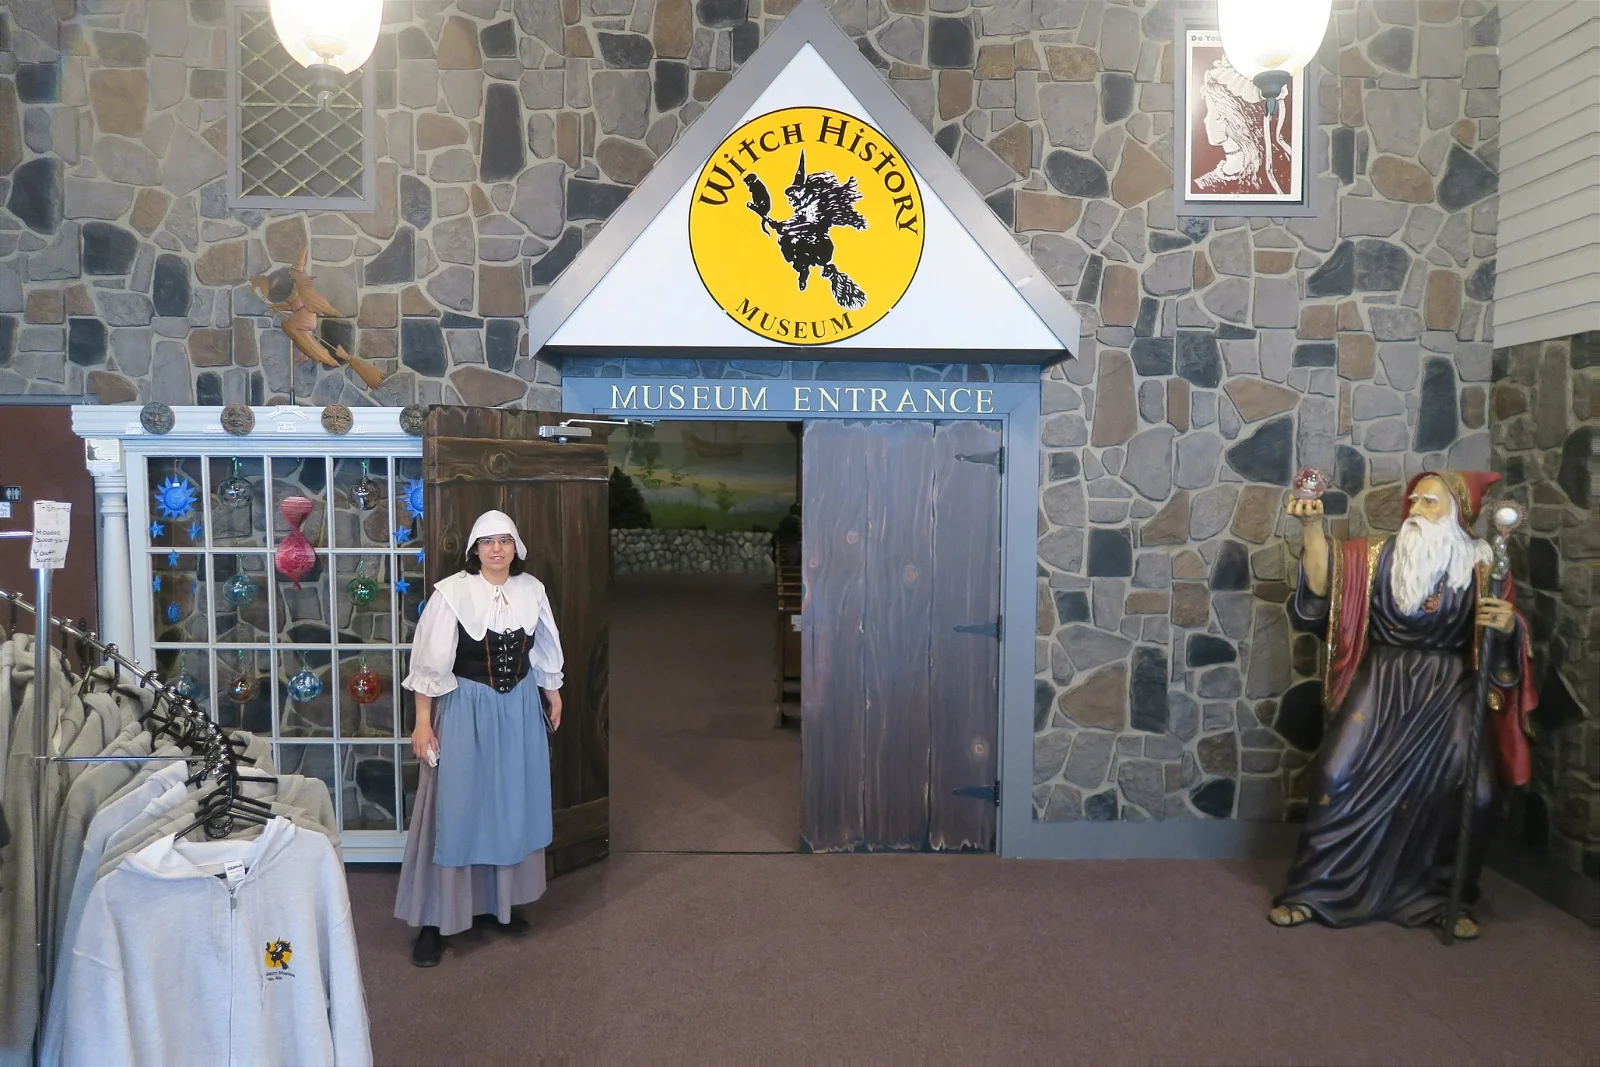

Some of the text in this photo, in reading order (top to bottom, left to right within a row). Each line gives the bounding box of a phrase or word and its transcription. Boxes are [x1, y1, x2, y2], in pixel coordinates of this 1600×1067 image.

[735, 298, 854, 339] MUSEUM
[610, 385, 995, 414] MUSEUM ENTRANCE
